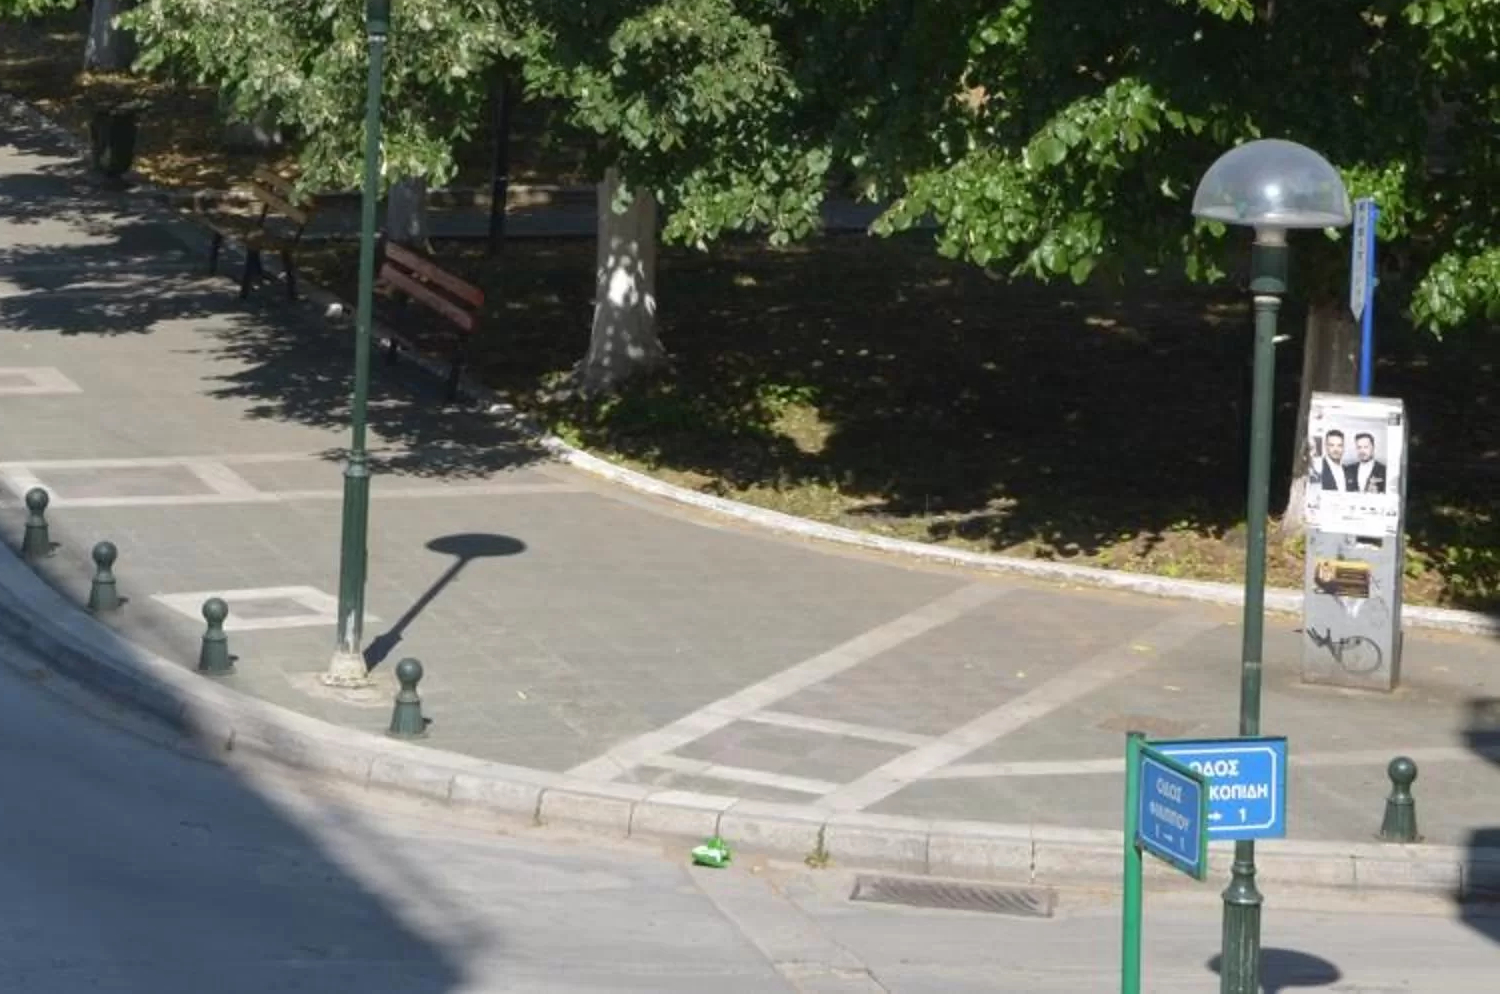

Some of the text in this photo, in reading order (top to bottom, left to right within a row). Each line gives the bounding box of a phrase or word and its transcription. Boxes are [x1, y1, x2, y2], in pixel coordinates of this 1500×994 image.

[1188, 759, 1240, 777] ΟΔΟΣ
[1209, 783, 1268, 801] ΚΟΠΙΔΗ
[1239, 807, 1247, 823] 1
